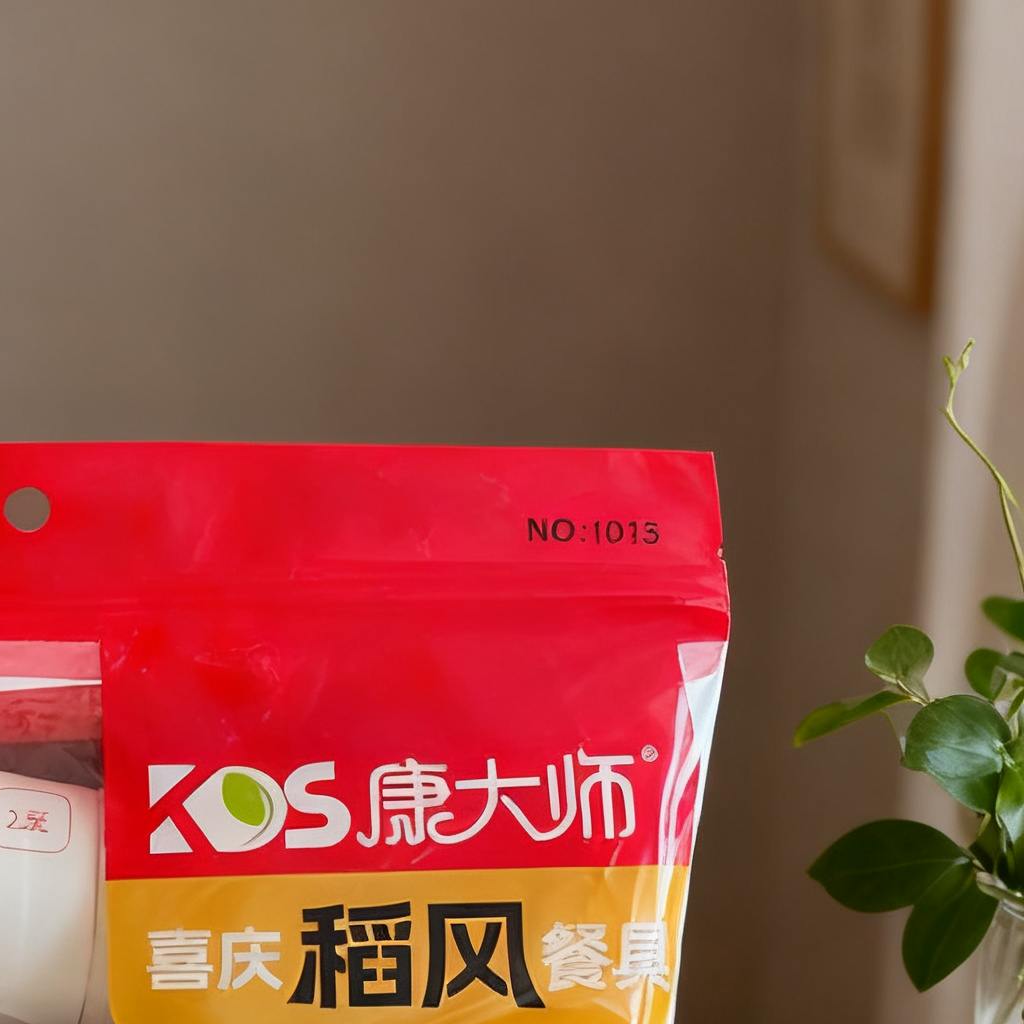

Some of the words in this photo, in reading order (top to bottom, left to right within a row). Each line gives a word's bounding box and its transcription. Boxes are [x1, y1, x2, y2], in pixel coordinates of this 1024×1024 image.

[527, 518, 659, 544] NO:1015
[148, 761, 352, 854] KOS
[356, 747, 637, 846] 康大师
[146, 927, 284, 991] 喜庆
[286, 901, 546, 1009] 稻风
